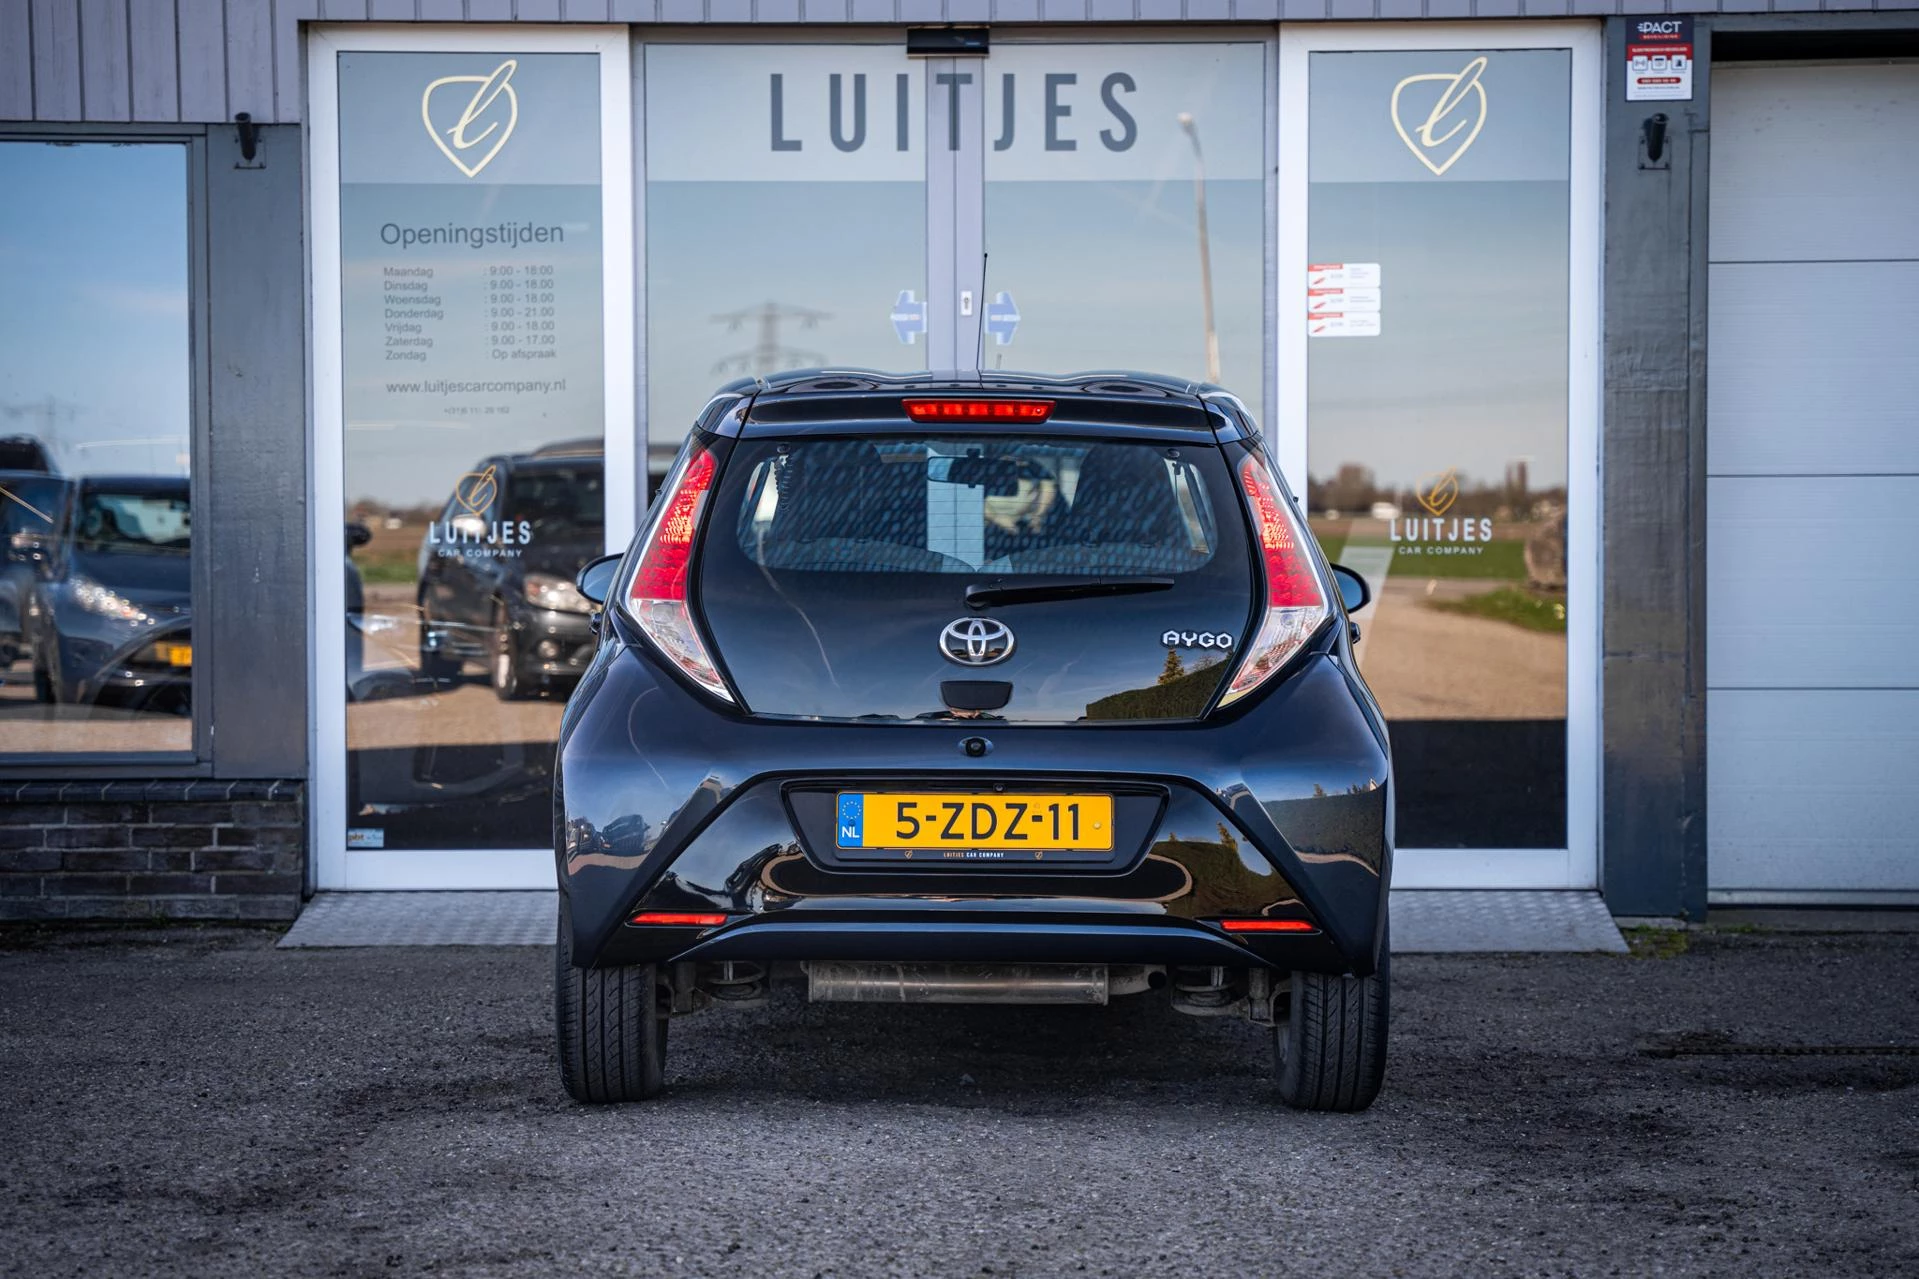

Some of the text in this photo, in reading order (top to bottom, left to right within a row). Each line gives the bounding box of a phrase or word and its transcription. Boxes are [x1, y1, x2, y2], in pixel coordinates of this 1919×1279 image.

[1643, 21, 1682, 33] PACT
[770, 72, 1138, 153] LUITJES
[380, 222, 565, 249] Openingstijden
[386, 379, 566, 396] www.luitjescarcompany.nl
[1390, 518, 1492, 541] LUITJES
[438, 548, 522, 557] CAR COMPANY
[1400, 546, 1483, 554] CAR COMPANY
[1162, 630, 1233, 649] AYGO
[896, 802, 1080, 840] 5-ZDZ-11
[841, 826, 860, 838] NL
